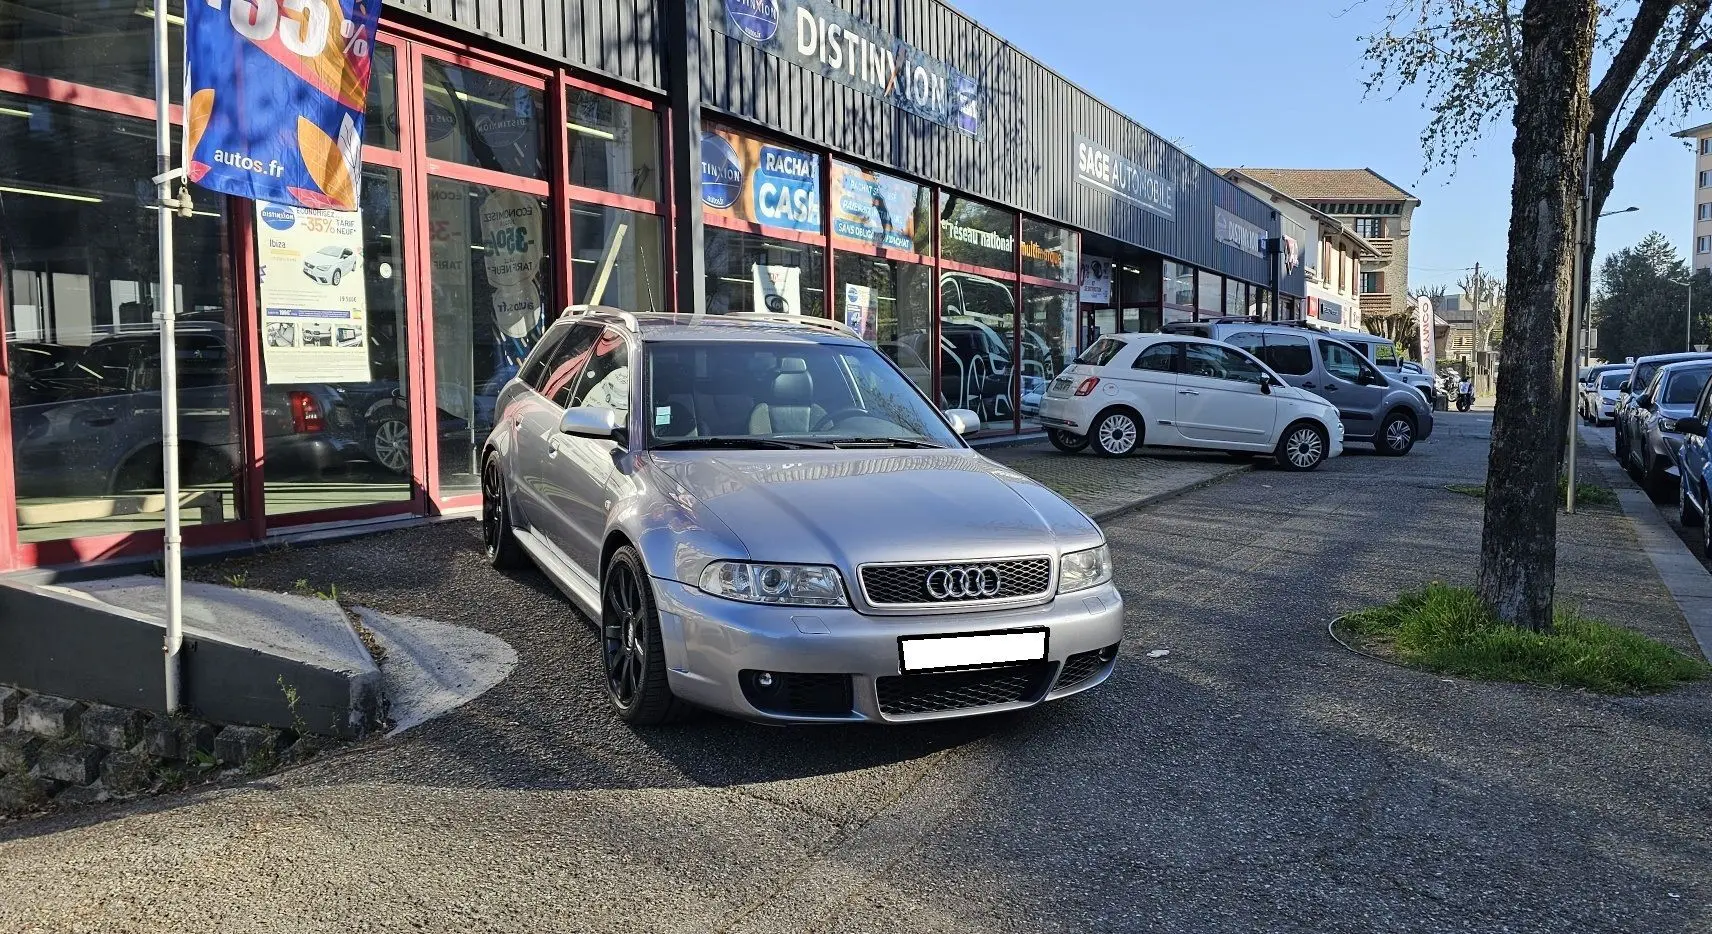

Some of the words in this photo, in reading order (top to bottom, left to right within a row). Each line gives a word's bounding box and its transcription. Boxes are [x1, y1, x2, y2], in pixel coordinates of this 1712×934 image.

[797, 6, 946, 116] DISTINXION
[214, 149, 285, 178] autos.fr
[1079, 142, 1110, 182] SAGE
[1111, 159, 1172, 210] AUTOMOBILE
[758, 182, 820, 225] CASH
[301, 216, 336, 234] -35%
[336, 219, 355, 227] TARIF
[950, 220, 979, 245] réseau
[269, 238, 286, 248] Ibiza
